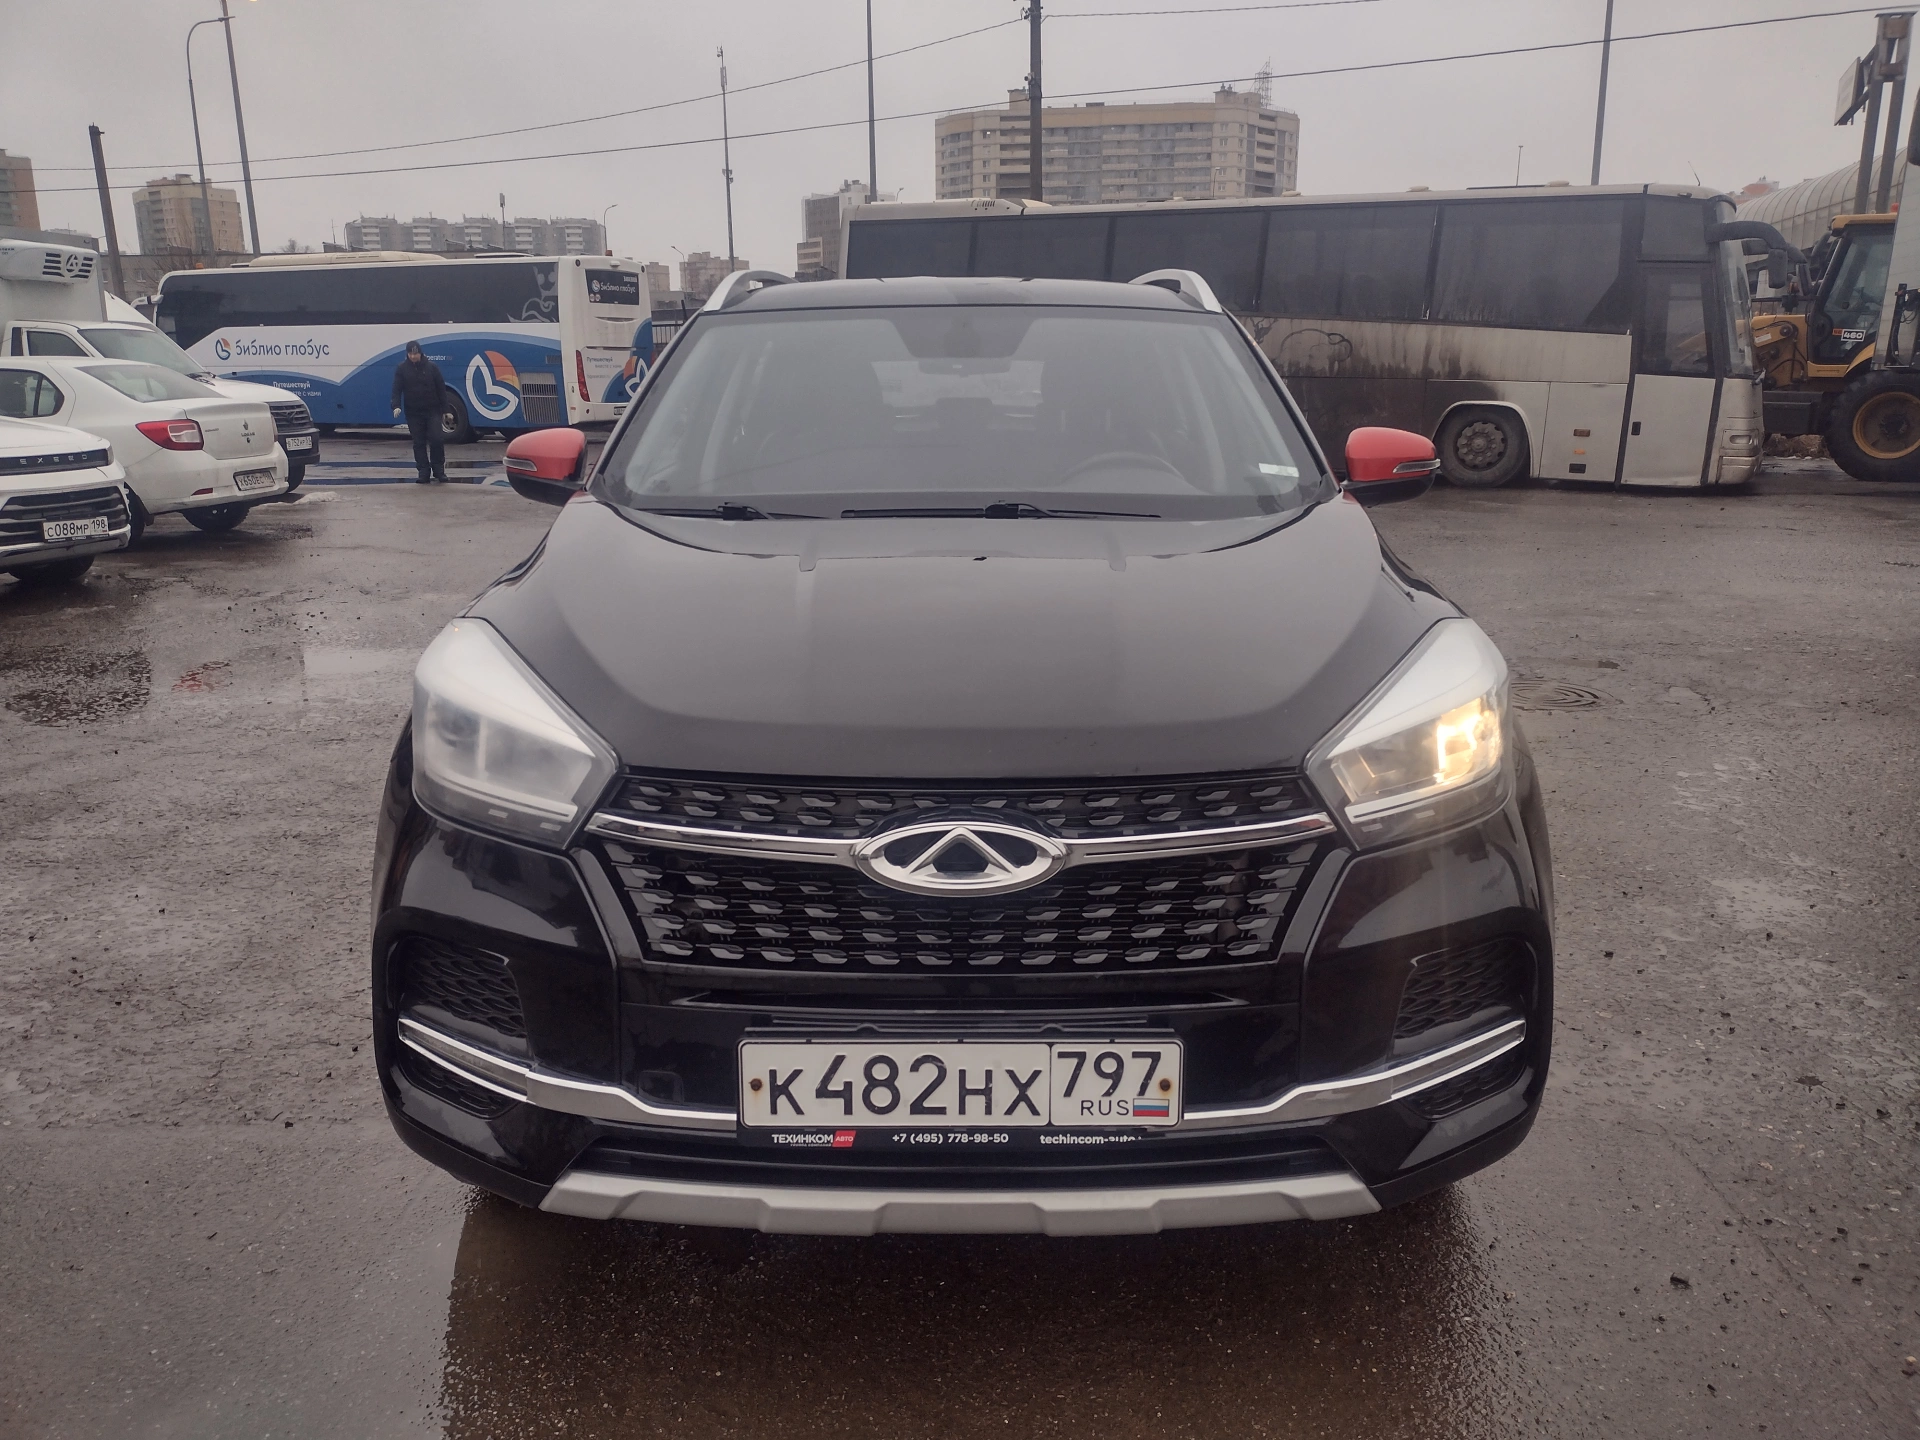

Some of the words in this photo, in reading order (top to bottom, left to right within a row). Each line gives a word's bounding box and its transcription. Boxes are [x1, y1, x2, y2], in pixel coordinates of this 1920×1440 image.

[1843, 331, 1863, 339] 460
[235, 339, 281, 356] библио
[285, 338, 330, 359] глобус
[47, 522, 89, 537] С088МР
[91, 519, 106, 529] 198
[768, 1054, 1043, 1116] К482НХ
[1056, 1051, 1163, 1098] 797
[1080, 1099, 1130, 1116] RUS
[772, 1134, 834, 1144] ТЕХИНКОМ
[892, 1134, 907, 1143] +7
[910, 1133, 943, 1144] (495)
[948, 1133, 1009, 1143] 778-98-50
